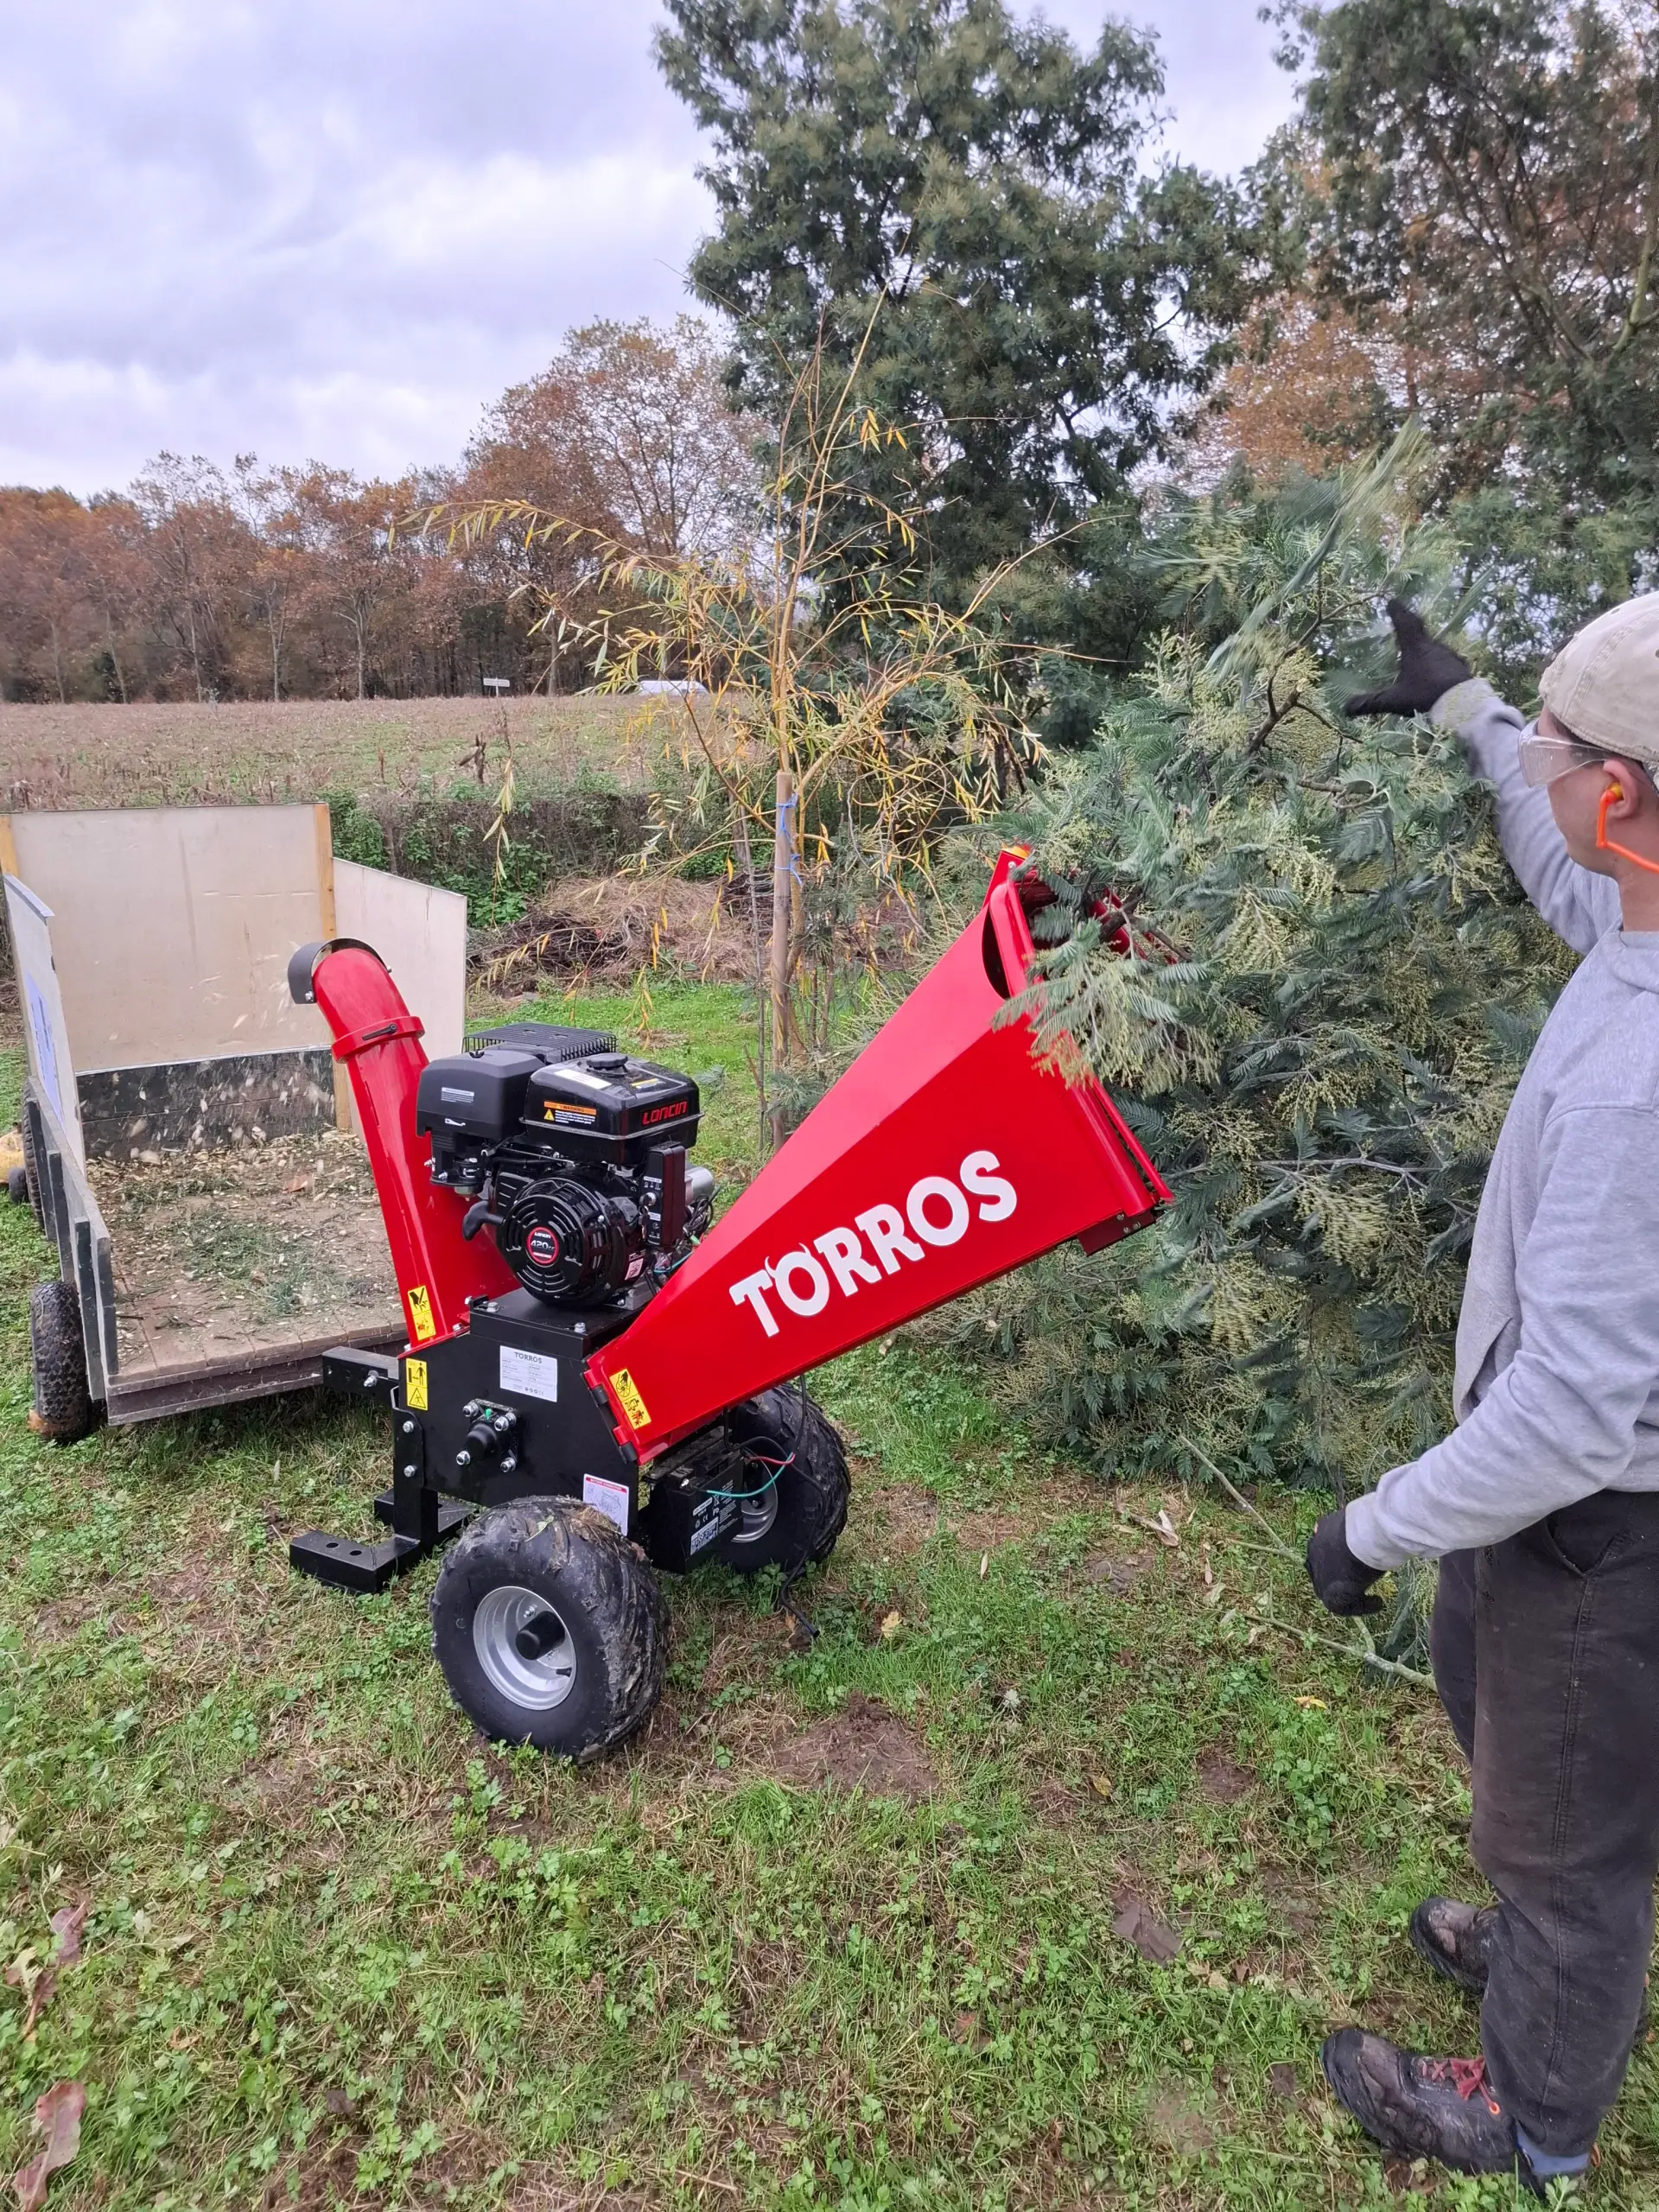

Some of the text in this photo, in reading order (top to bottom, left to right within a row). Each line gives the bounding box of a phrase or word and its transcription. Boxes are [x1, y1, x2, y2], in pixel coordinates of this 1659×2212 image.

[642, 1101, 688, 1125] LONCIN
[728, 1150, 1018, 1338] TORROS
[514, 1351, 543, 1364] TORROS
